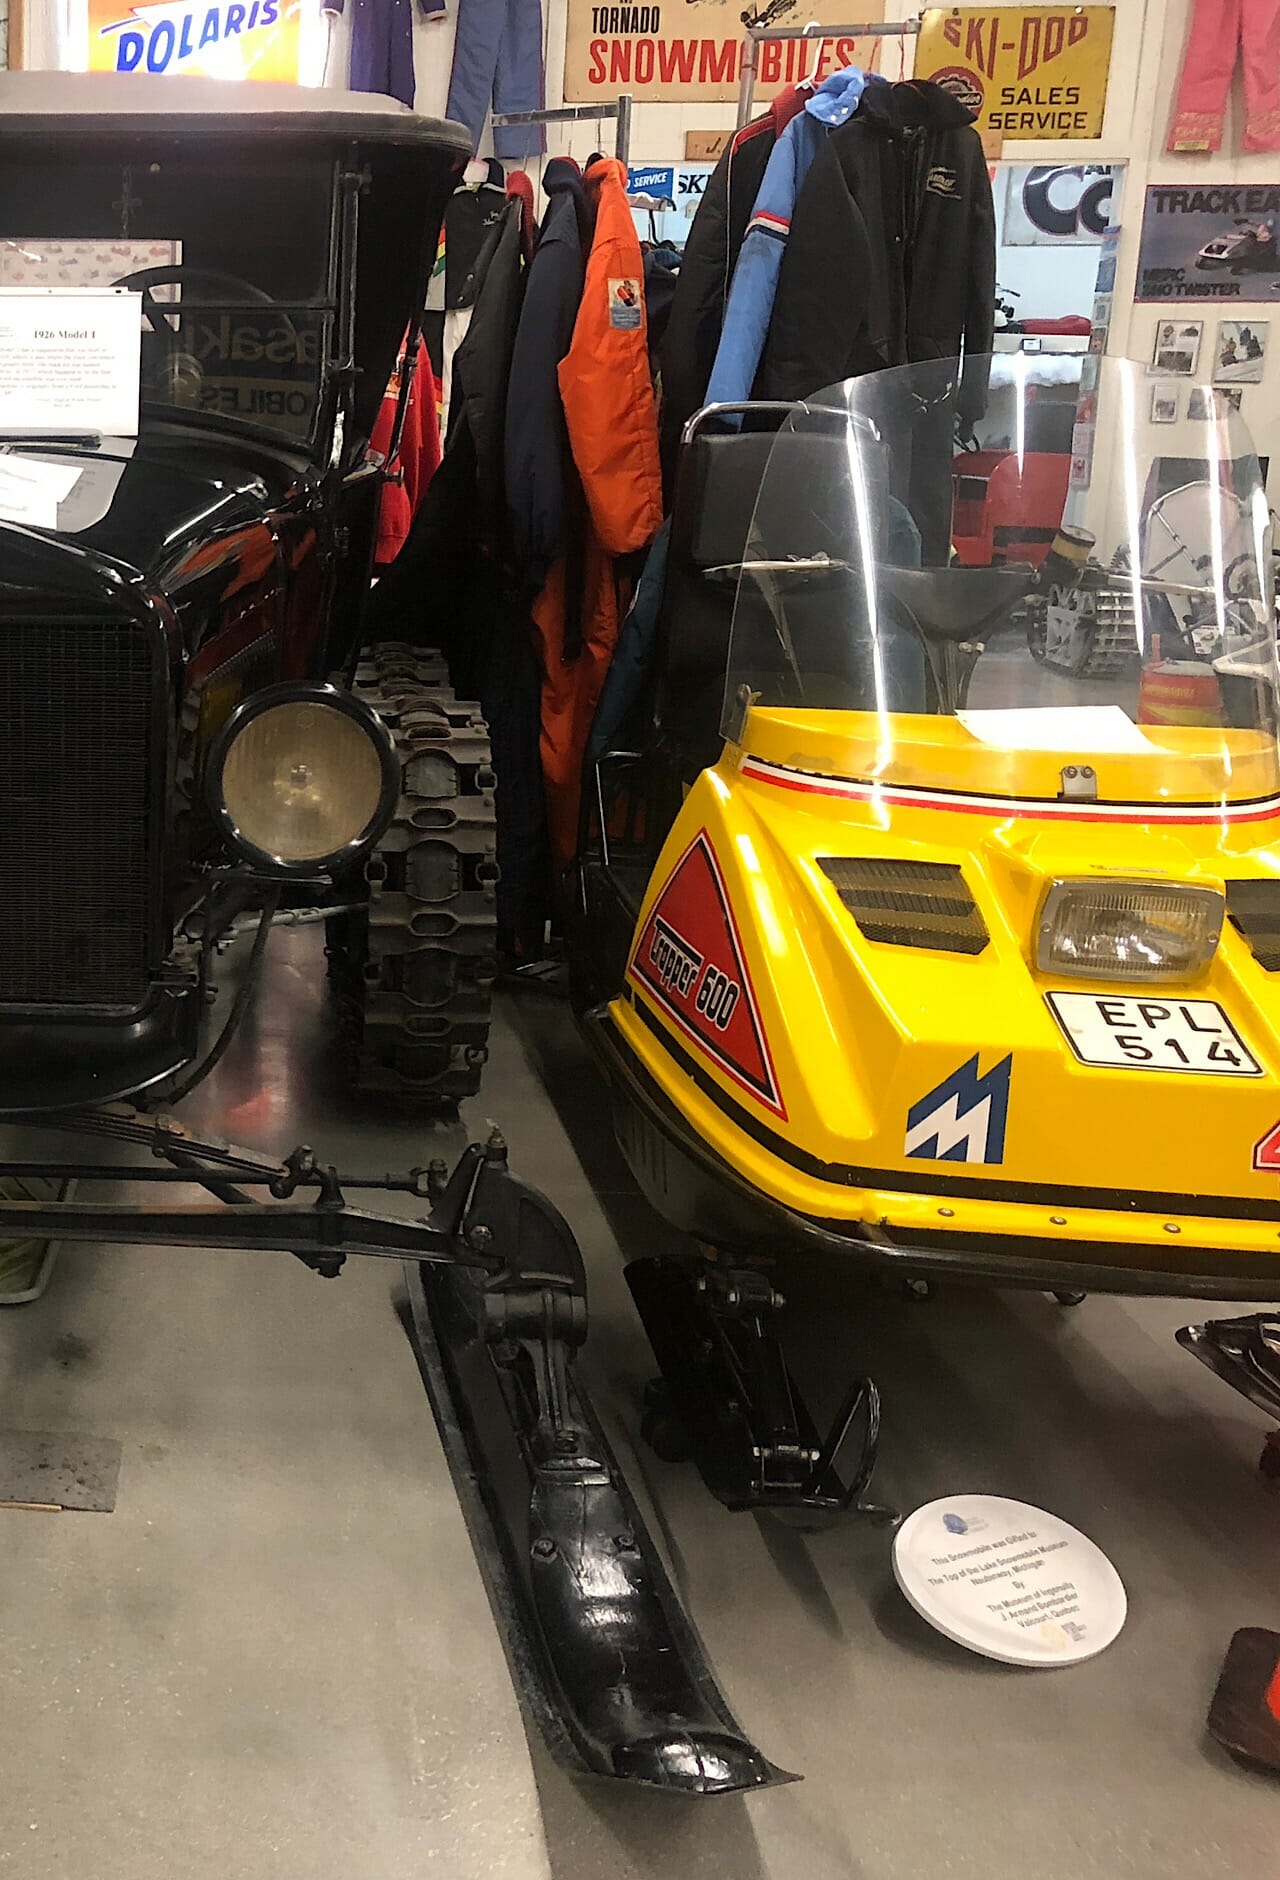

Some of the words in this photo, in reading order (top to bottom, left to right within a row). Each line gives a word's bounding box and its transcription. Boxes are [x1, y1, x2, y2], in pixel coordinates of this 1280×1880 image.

[591, 6, 660, 34] TORNADO
[116, 0, 279, 73] POLARIS
[943, 16, 1089, 81] SKI-DOO
[1000, 87, 1081, 106] SALES
[988, 112, 1089, 130] SERVICE
[633, 171, 669, 188] SERVICE
[1151, 189, 1243, 214] TRACK
[1174, 283, 1241, 297] TWISTER
[34, 330, 55, 340] 1926
[58, 330, 88, 340] Model
[695, 963, 740, 1031] 600
[1095, 1000, 1222, 1034] EPL
[1114, 1034, 1242, 1067] 514
